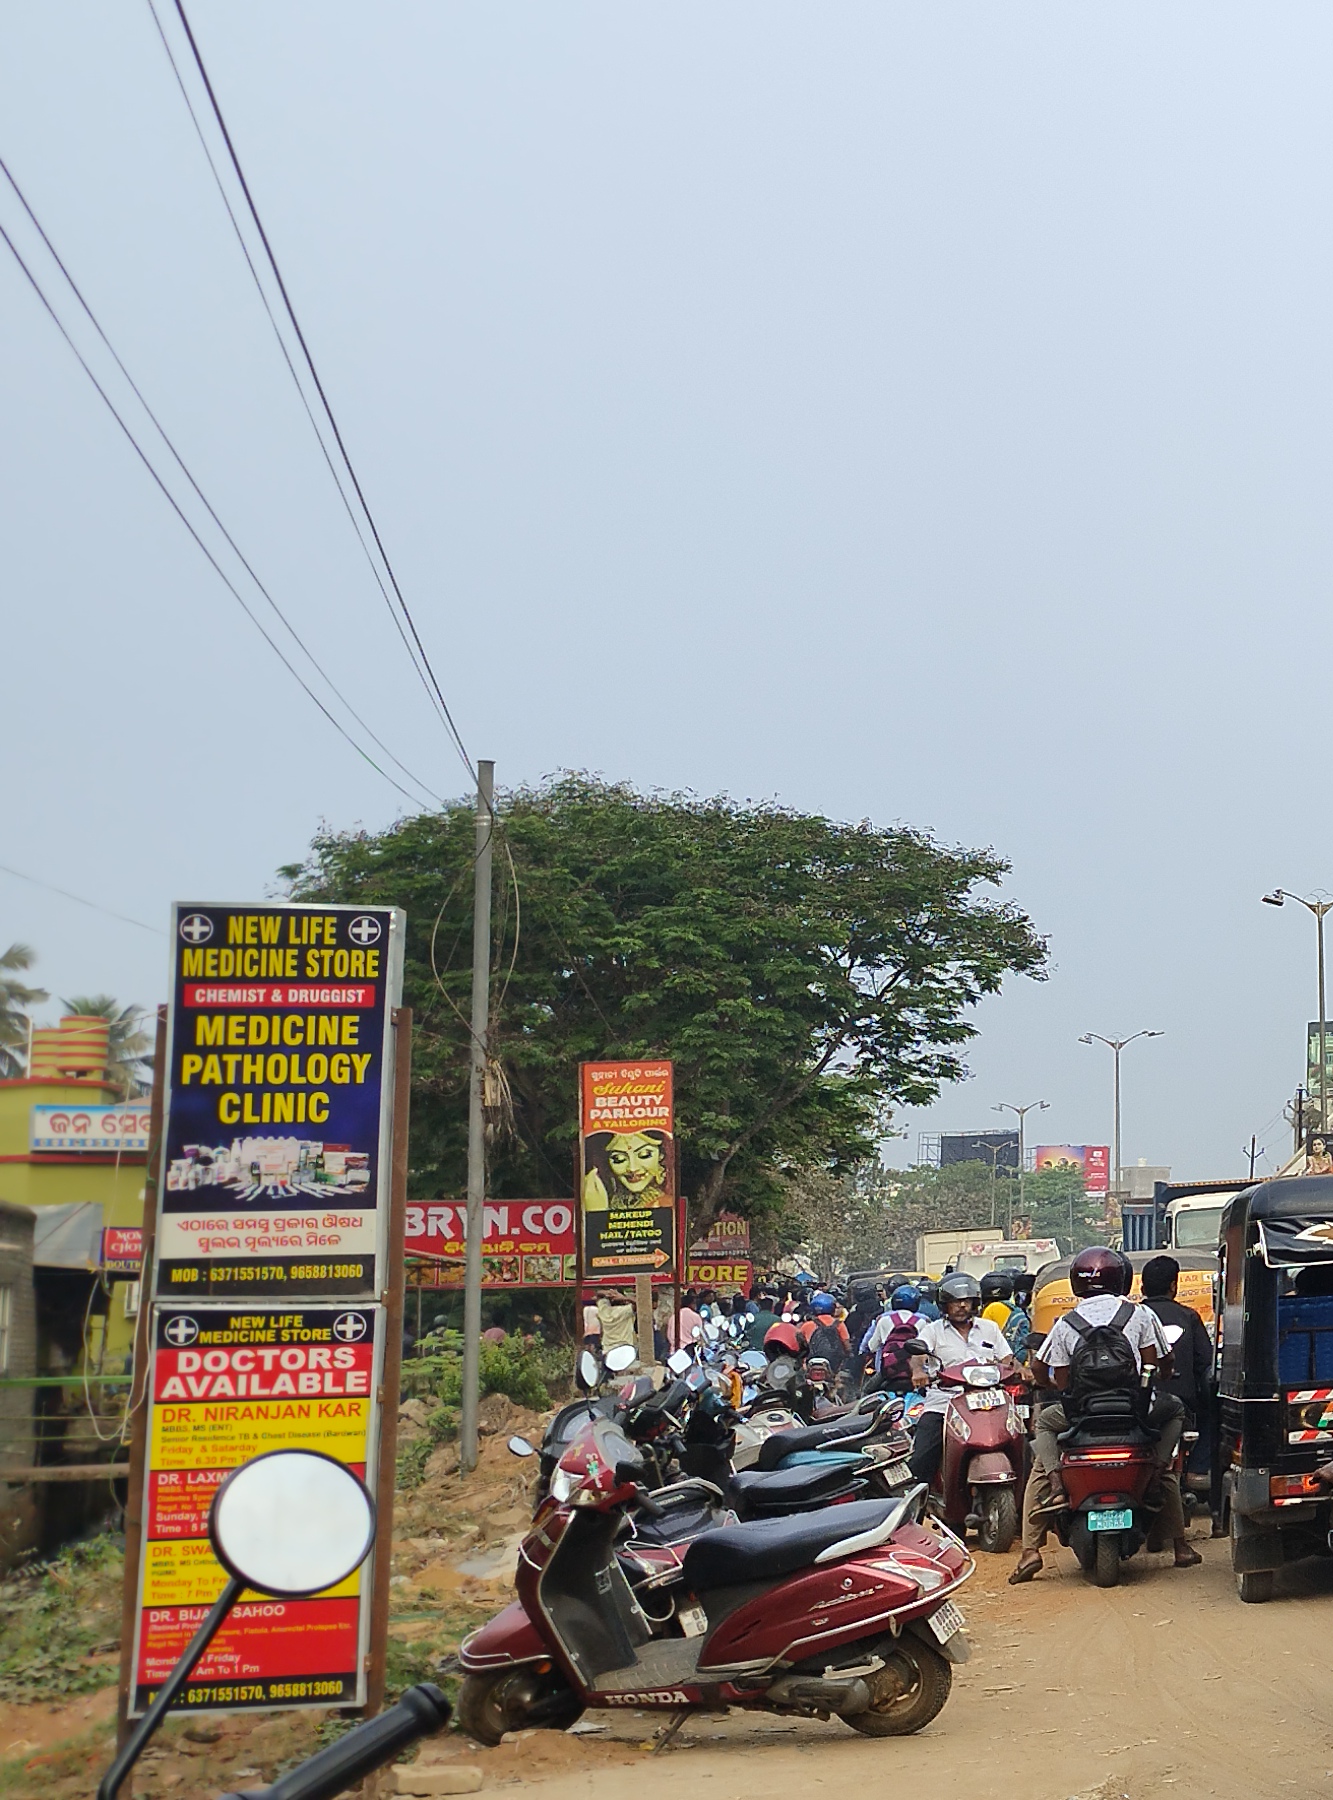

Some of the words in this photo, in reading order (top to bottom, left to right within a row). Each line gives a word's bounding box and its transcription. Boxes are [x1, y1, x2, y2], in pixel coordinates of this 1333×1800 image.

[227, 916, 281, 944] NEW
[289, 916, 337, 945] LIFE
[182, 948, 298, 977] MEDICINE
[306, 949, 379, 978] STORE
[195, 989, 266, 1003] CHEMIST
[271, 989, 282, 1003] &
[288, 989, 365, 1003] DRUGGIST
[196, 1015, 360, 1046] MEDICINE
[181, 1053, 371, 1084] PATHOLOGY
[592, 1081, 666, 1095] Suhani
[219, 1092, 329, 1124] CLINIC
[595, 1095, 664, 1107] BEAUTY
[589, 1107, 669, 1119] PARLOUR
[50, 1113, 91, 1134] ଜନ
[603, 1119, 667, 1128] TAILORING
[610, 1211, 653, 1219] MAKEUP
[177, 1217, 229, 1231] ଏଠାରେ
[273, 1216, 319, 1233] ପ୍ରକାର
[608, 1220, 654, 1229] MEHENDI
[171, 1269, 199, 1283] MOB
[210, 1266, 287, 1282] 6371551570,
[290, 1264, 363, 1279] 9658813060
[230, 1316, 264, 1330] NEW
[270, 1315, 304, 1328] LIFE
[199, 1330, 276, 1344] MEDICINE
[281, 1328, 331, 1342] STORE
[177, 1347, 356, 1373] DOCTORS
[161, 1371, 368, 1399] AVAILABLE
[161, 1408, 196, 1423] DR.
[204, 1404, 310, 1422] NIRANJAN
[318, 1402, 361, 1418] KAR
[158, 1473, 183, 1485] DR.
[155, 1524, 181, 1534] Time
[152, 1546, 176, 1557] DR.
[151, 1578, 192, 1588] Monday
[152, 1592, 176, 1600] Time
[149, 1611, 174, 1622] DR.
[232, 1605, 286, 1618] SAHOO
[207, 1654, 241, 1664] Friday
[196, 1667, 214, 1676] Am
[242, 1665, 259, 1673] Pm
[188, 1685, 266, 1703] 6371551570,
[270, 1681, 343, 1698] 9658813060
[605, 1691, 690, 1705] HONDA
